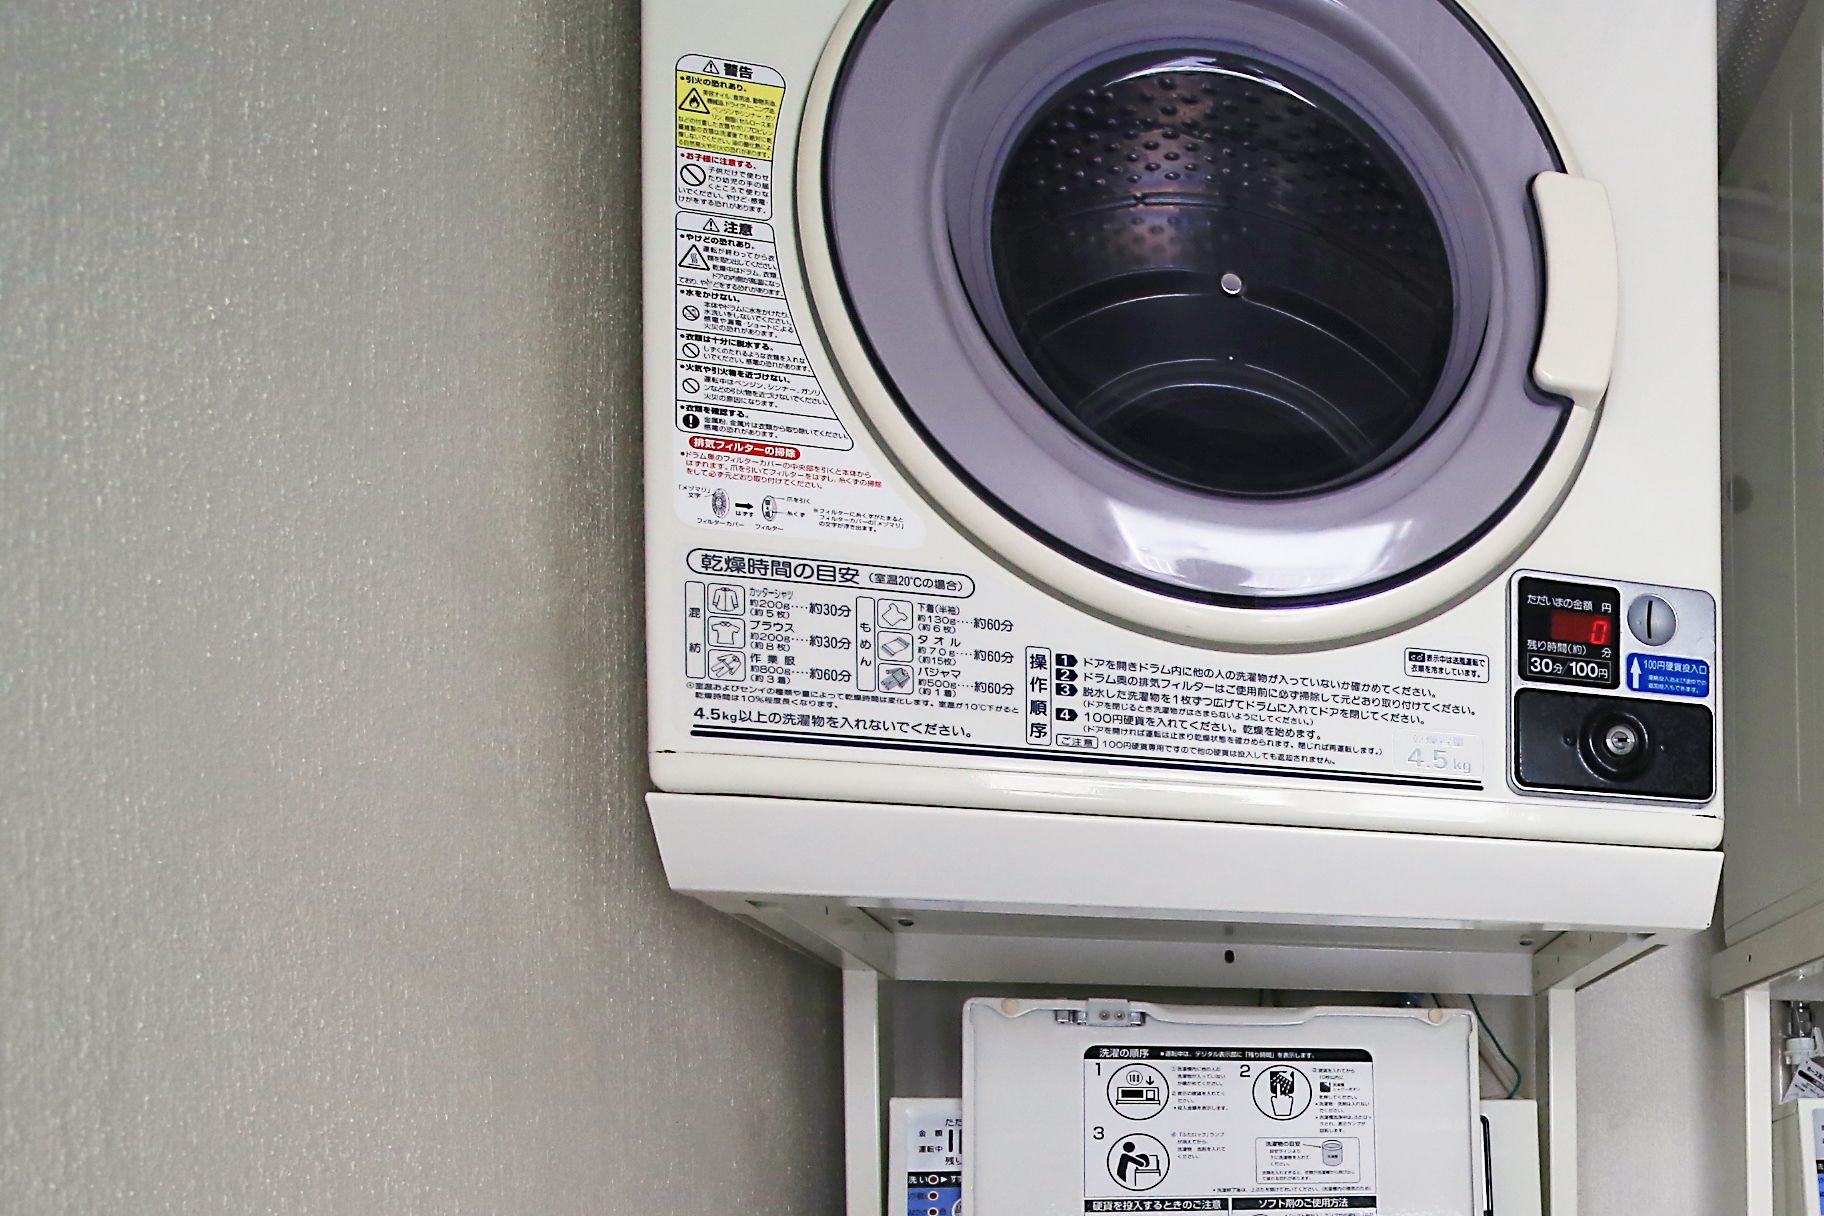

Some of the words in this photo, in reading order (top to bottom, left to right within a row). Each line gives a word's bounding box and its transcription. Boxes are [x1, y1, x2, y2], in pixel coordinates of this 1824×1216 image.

[724, 63, 753, 79] 警告
[686, 76, 747, 92] 引火の恐れあり。
[686, 153, 756, 168] お子様に注意する。
[708, 167, 768, 180] 子供だけで使わせ
[708, 175, 768, 189] たり幼児の手の届
[708, 184, 768, 197] くところで使わな
[679, 196, 766, 213] けがをする恐れがあります。
[724, 221, 753, 236] 注意
[686, 234, 755, 249] やけどの恐れあり。
[703, 246, 775, 261] 運転が終わってから衣
[686, 290, 740, 302] 水をかけない。
[704, 324, 778, 338] 火災の恐れがあります。
[686, 334, 773, 350] 衣類は十分に脱水する。
[686, 364, 790, 383] 火気や引火物を近づけない。
[704, 393, 778, 408] 火災の原因になります。
[686, 405, 748, 418] 衣類を確認する。
[704, 424, 778, 439] 感電の恐れがあります。
[694, 438, 796, 457] 排気フィルターの掃除
[701, 554, 859, 584] 乾燥時間の目安
[750, 588, 793, 599] カッターシャツ
[810, 603, 851, 617] 約30分
[1527, 594, 1593, 611] ただいまの金額
[1602, 603, 1611, 613] 円
[750, 620, 795, 633] ブラウス
[974, 618, 1013, 632] 約60分
[1591, 621, 1609, 644] 0
[810, 636, 851, 649] 約30分
[974, 650, 1014, 663] 約60分
[810, 668, 851, 682] 約60分
[1061, 669, 1070, 681] 2
[1062, 656, 1068, 666] 1
[1083, 657, 1435, 698] ドアを開きドラム内に他の人の洗濯物が入っていないか確かめてください。
[975, 682, 1014, 695] 約60分
[1060, 685, 1070, 695] 3
[1030, 654, 1047, 738] 操作順序
[1060, 709, 1070, 720] 4
[693, 707, 972, 738] 4.5kg以上の洗濯物を入れないでください。
[1060, 737, 1093, 747] ご注意
[1100, 1048, 1149, 1058] 洗濯の順序
[1096, 1063, 1101, 1076] 1
[1240, 1065, 1250, 1078] 2
[1093, 1127, 1104, 1140] 3
[1092, 1200, 1222, 1211] 硬貨を投入するときのご注意
[1258, 1198, 1348, 1208] ソフト剤のご使用方法
